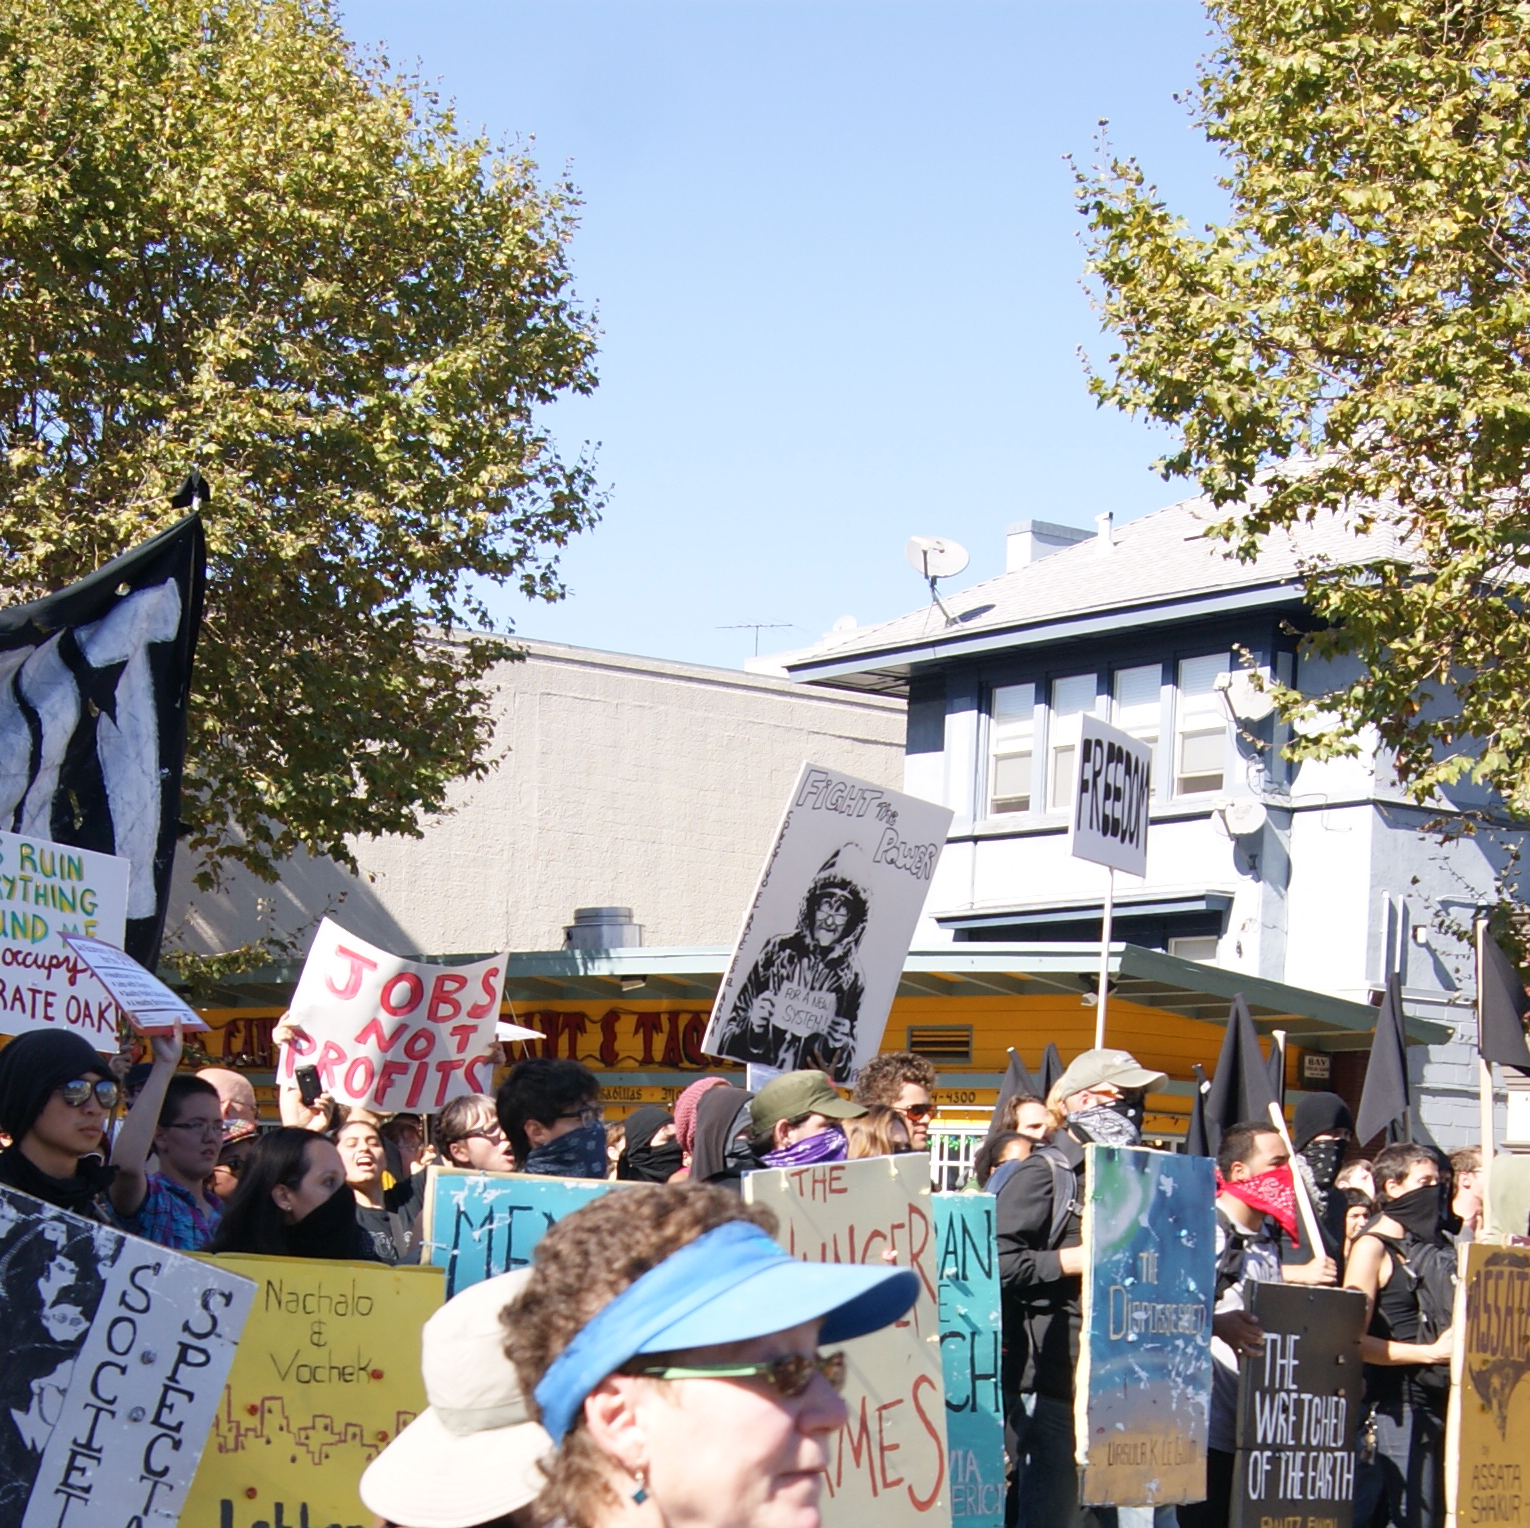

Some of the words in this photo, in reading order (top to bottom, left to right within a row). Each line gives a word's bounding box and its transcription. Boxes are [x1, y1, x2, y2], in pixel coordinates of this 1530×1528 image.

[1077, 738, 1150, 857] FREEDOM
[20, 842, 85, 882] RUIN
[324, 944, 500, 1026] JOBS
[785, 988, 801, 1001] FOR
[803, 991, 810, 1005] A
[355, 1017, 479, 1061] NOT
[286, 1030, 493, 1109] PROFITS
[790, 1166, 848, 1203] THE
[265, 1279, 373, 1318] Nachalo
[309, 1319, 328, 1348] &
[269, 1346, 373, 1384] Vochek
[1262, 1332, 1300, 1390] THE
[1255, 1390, 1347, 1447] WRETCHED
[1150, 1439, 1161, 1466] K
[1248, 1451, 1271, 1500] OF
[1275, 1451, 1305, 1500] THE
[1308, 1451, 1354, 1500] EARTH
[1471, 1463, 1522, 1491] ASSATA
[1471, 1495, 1521, 1524] SHAKUR
